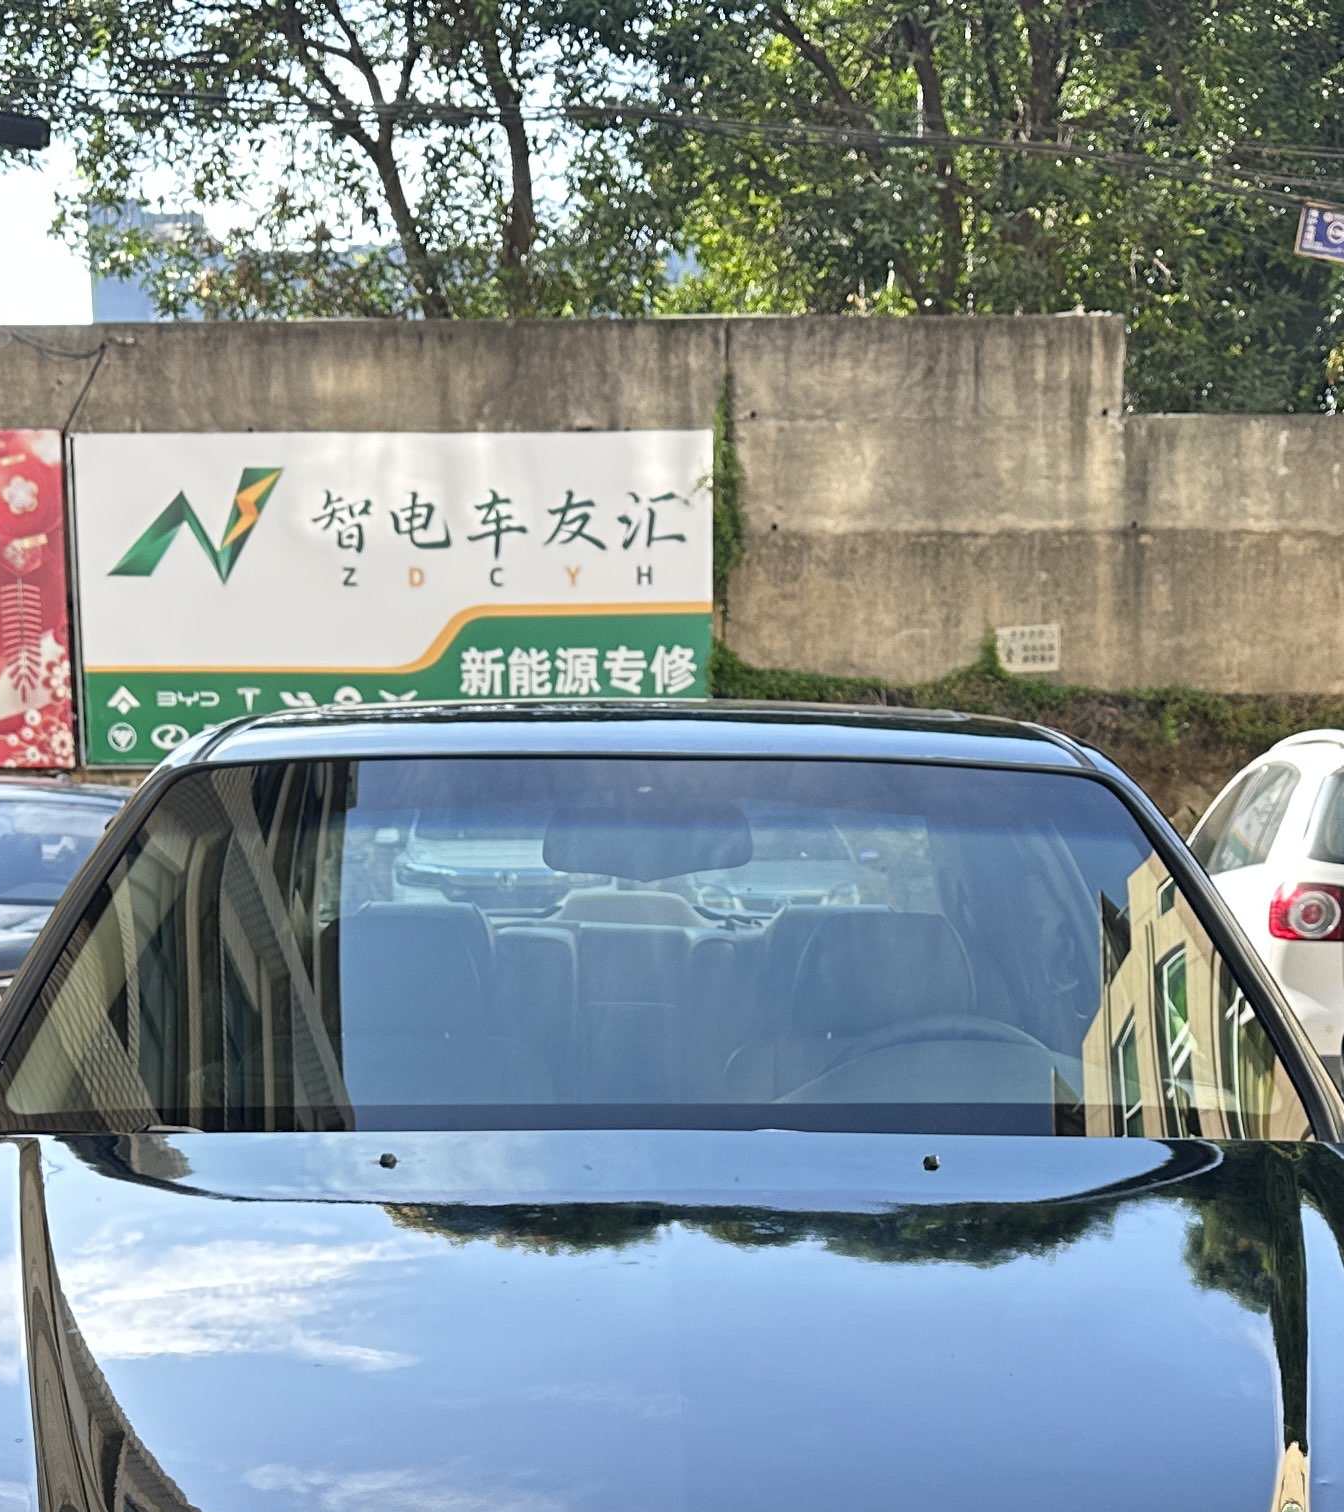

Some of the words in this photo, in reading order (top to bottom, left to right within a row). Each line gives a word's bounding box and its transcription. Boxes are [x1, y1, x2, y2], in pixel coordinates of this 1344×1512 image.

[312, 489, 687, 559] 智电车友汇
[460, 645, 698, 696] 新能源专修
